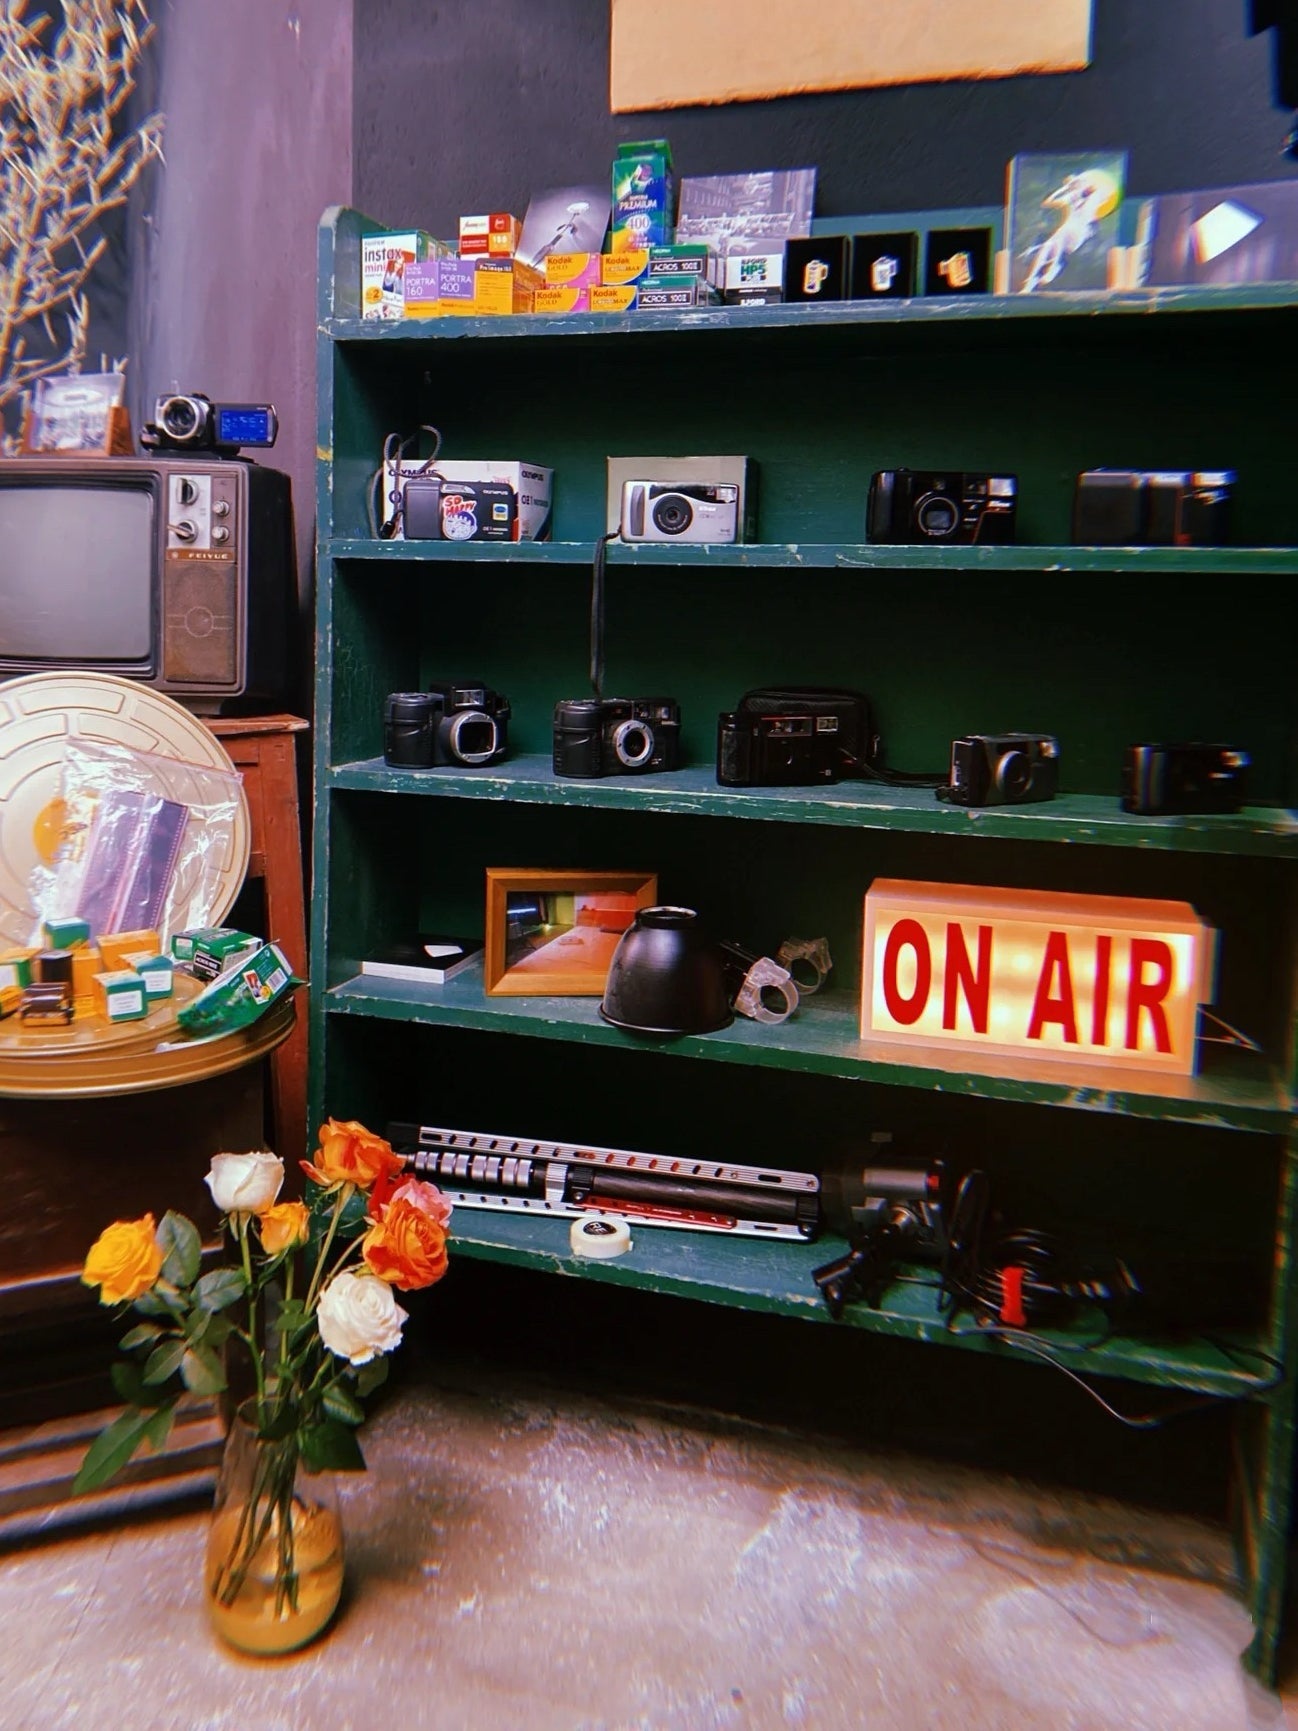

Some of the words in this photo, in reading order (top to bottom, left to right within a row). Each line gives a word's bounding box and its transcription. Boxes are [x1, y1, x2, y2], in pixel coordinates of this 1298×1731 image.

[619, 199, 657, 212] PREMIUM
[628, 217, 648, 230] 400
[364, 246, 402, 263] instax
[547, 256, 572, 265] Kodak
[605, 256, 630, 265] Kodak
[652, 262, 679, 272] ACROS
[740, 264, 767, 276] HP5
[406, 277, 436, 287] PORTRA
[440, 273, 472, 284] PORTRA
[406, 286, 423, 296] 160
[440, 282, 460, 293] 400
[372, 288, 380, 299] 2
[537, 291, 562, 299] Kodak
[593, 289, 618, 298] Kodak
[641, 293, 667, 304] ACROS
[446, 502, 475, 516] HAPPY
[188, 552, 229, 560] FEIYUE
[883, 918, 993, 1034] ON
[1026, 930, 1174, 1054] AIR
